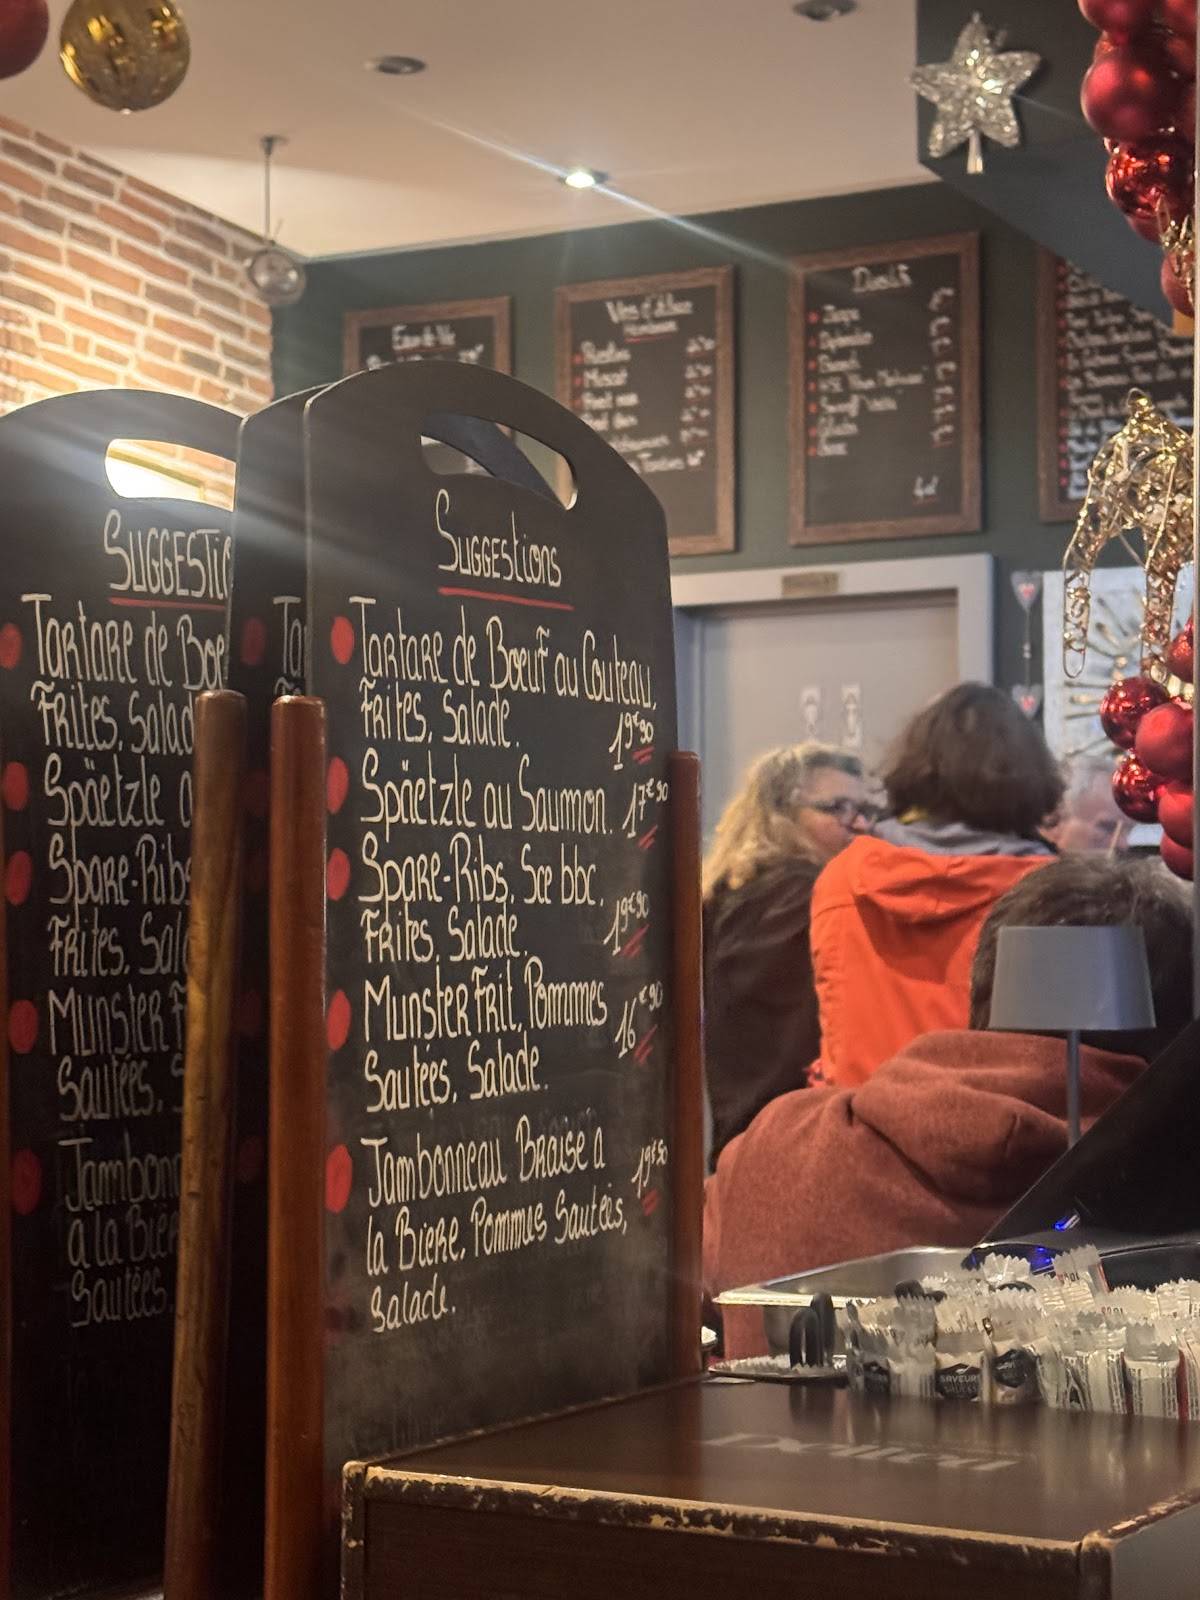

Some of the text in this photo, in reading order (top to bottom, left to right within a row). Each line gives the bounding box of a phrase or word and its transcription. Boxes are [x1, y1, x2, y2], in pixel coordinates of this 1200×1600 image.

[144, 610, 173, 687] de
[273, 596, 307, 677] Ta
[453, 604, 480, 687] de
[554, 652, 578, 698] au
[442, 687, 520, 748] Salade.
[483, 782, 513, 830] au
[519, 753, 613, 835] Saumon.
[524, 955, 607, 1030] Pommes
[467, 1029, 549, 1100] Salade.
[360, 1132, 507, 1209] Jambonneau
[95, 1209, 124, 1269] la
[366, 1215, 389, 1276] la
[470, 1195, 548, 1258] Pommes
[371, 1272, 456, 1333] Salade.
